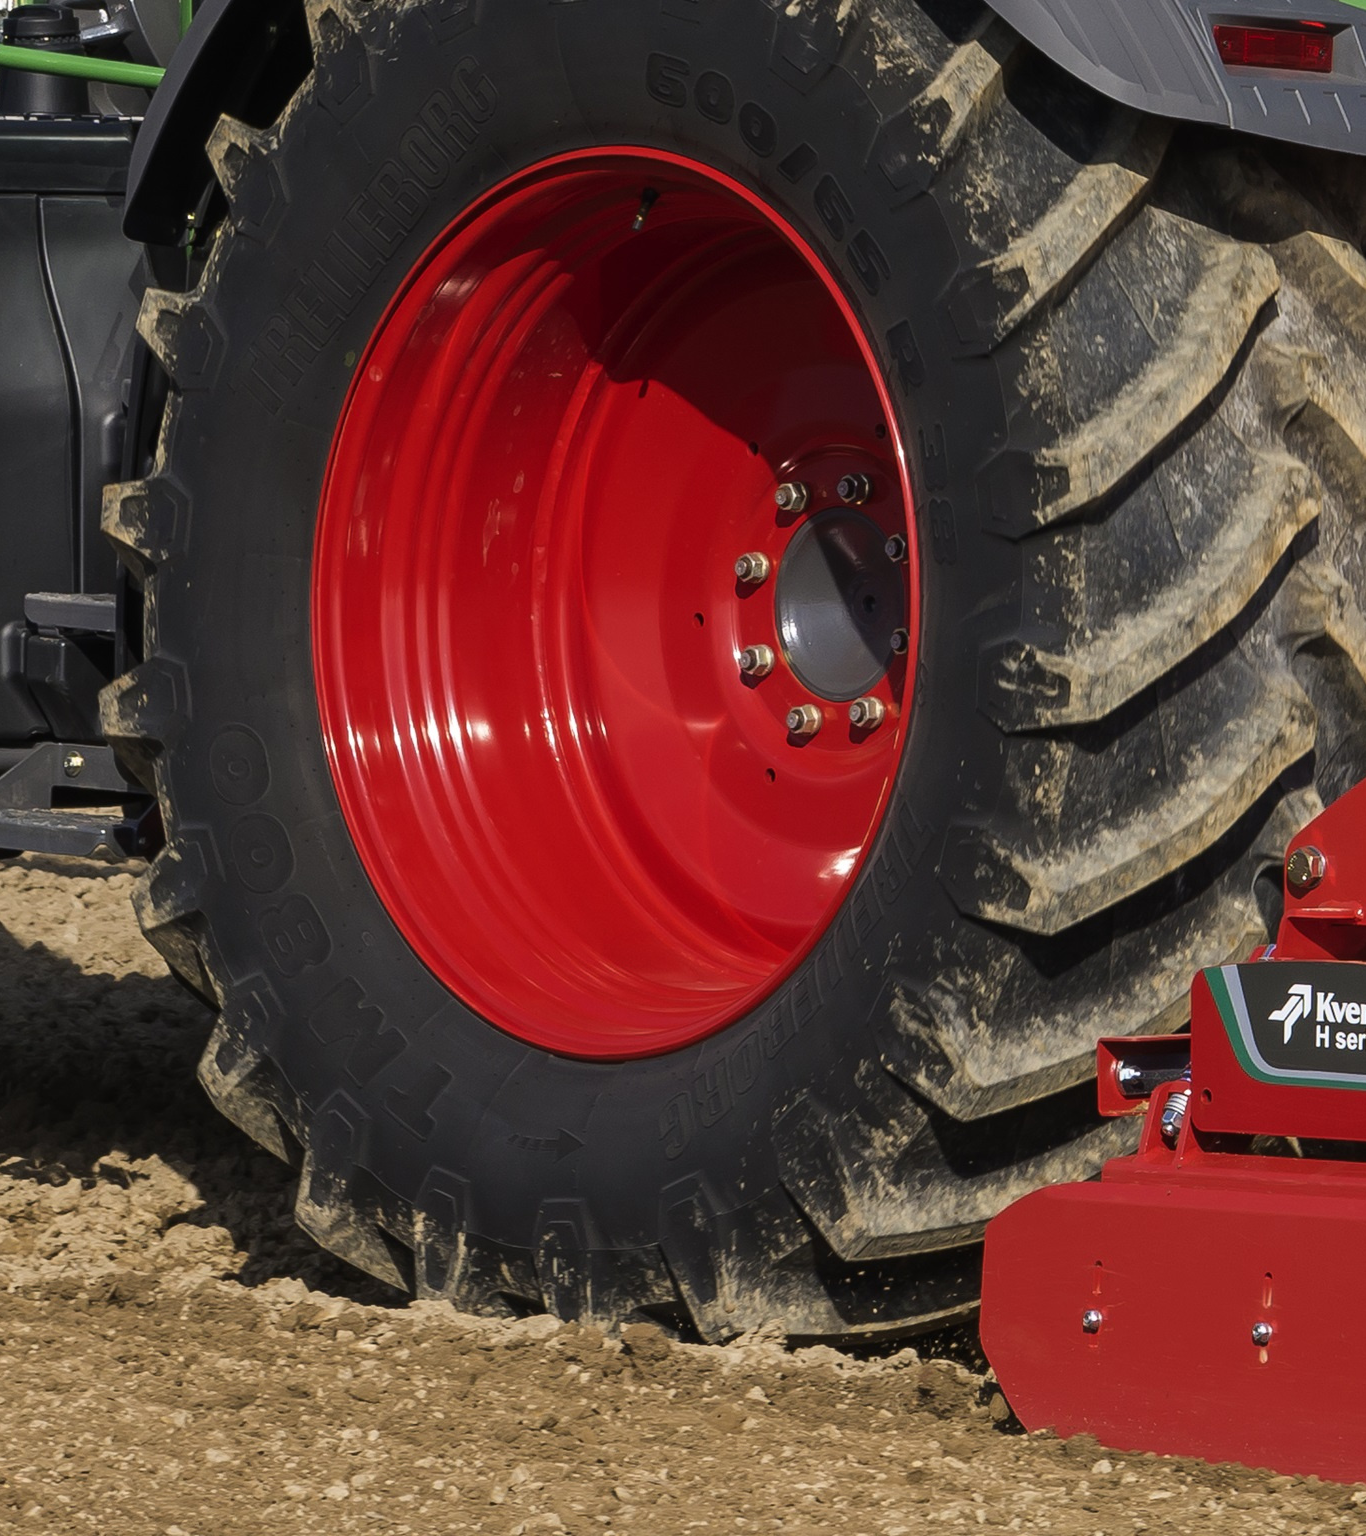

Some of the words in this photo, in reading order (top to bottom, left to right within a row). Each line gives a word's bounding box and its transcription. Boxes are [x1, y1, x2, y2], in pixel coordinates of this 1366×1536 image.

[228, 54, 499, 415] TRELLEBORG
[645, 51, 891, 296] 600/65
[885, 318, 928, 396] R
[1315, 1025, 1330, 1048] H
